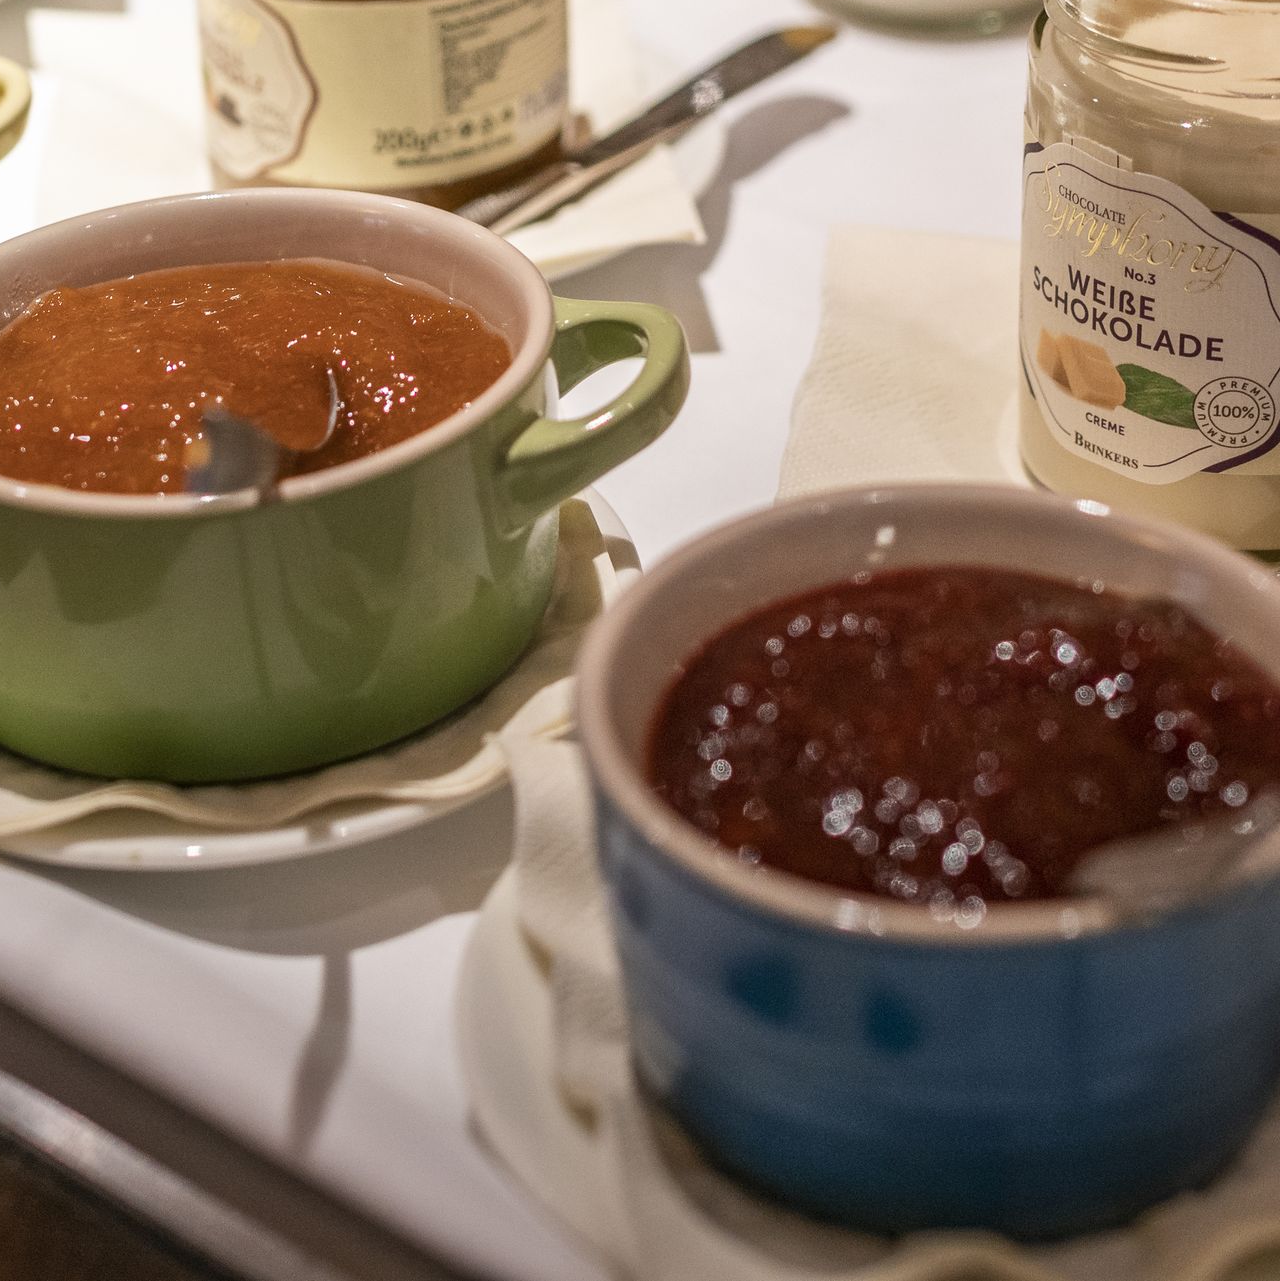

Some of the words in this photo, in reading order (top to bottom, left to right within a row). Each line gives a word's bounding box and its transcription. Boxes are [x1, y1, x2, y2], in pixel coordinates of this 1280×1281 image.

[1058, 184, 1126, 225] CHOCOLATE
[1038, 161, 1238, 294] Symphony
[1124, 266, 1156, 286] No.3
[1033, 265, 1224, 362] SCHOKOLADE
[1212, 404, 1255, 420] 100%
[1219, 380, 1273, 423] PREMIUM
[1085, 411, 1126, 436] CREME
[1195, 400, 1248, 445] PREMIUM
[1074, 430, 1139, 470] BRINKERS
